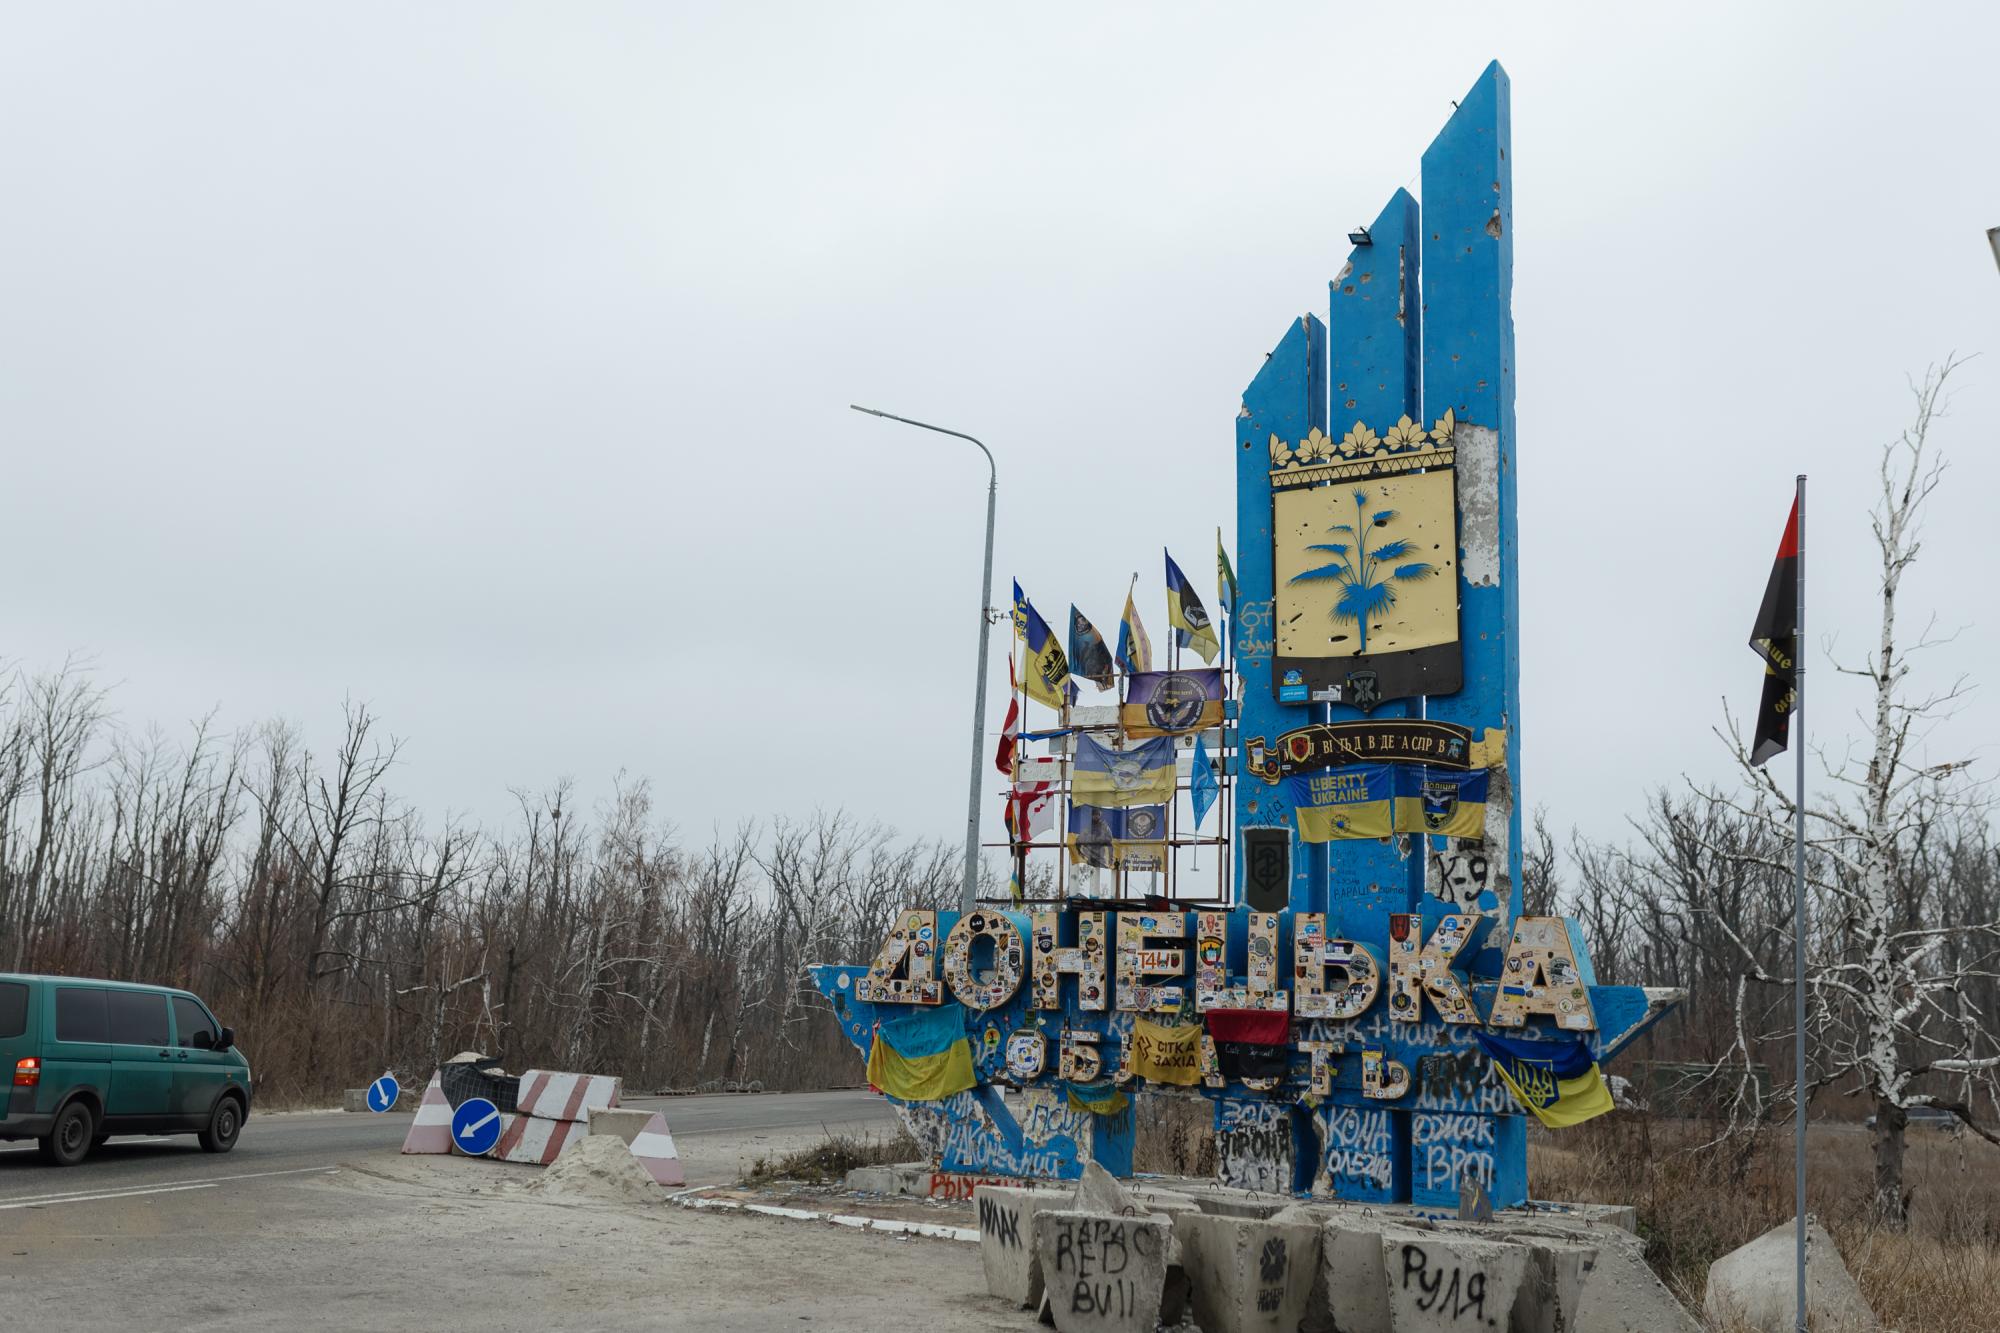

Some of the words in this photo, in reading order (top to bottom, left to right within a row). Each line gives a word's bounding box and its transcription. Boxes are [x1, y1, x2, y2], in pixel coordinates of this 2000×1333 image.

[1312, 787, 1368, 805] UKRAINE
[1423, 781, 1457, 791] ПОЛІЦІЯ
[855, 909, 1597, 1031] ДОНЕЦЬКА
[1153, 1054, 1197, 1068] ЗАХІД
[1326, 1105, 1392, 1153] КОМА
[1057, 1233, 1129, 1278] RED
